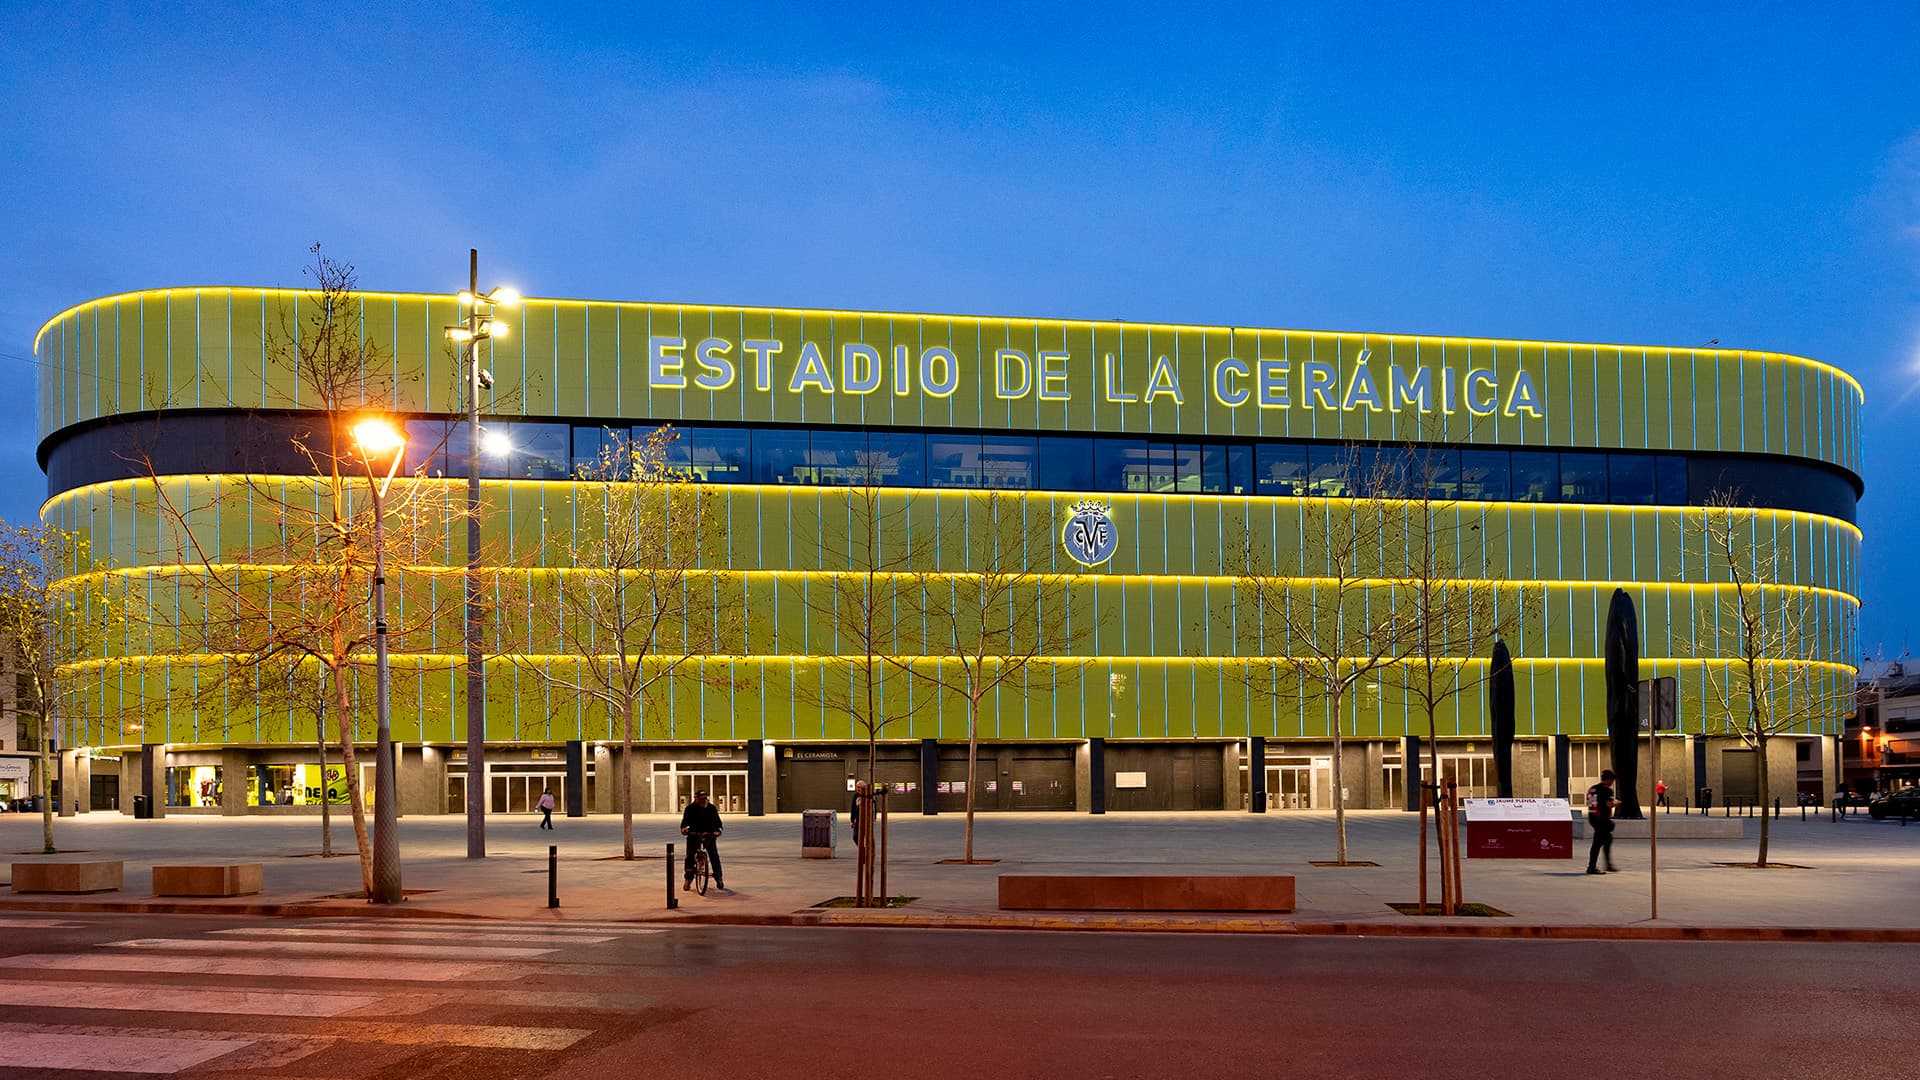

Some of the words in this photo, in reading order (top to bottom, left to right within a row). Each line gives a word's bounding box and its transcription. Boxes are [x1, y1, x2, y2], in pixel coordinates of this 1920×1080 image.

[648, 336, 959, 398] ESTADIO
[995, 349, 1071, 400] DE
[1105, 353, 1184, 404] LA
[1213, 349, 1544, 418] CERÁMICA
